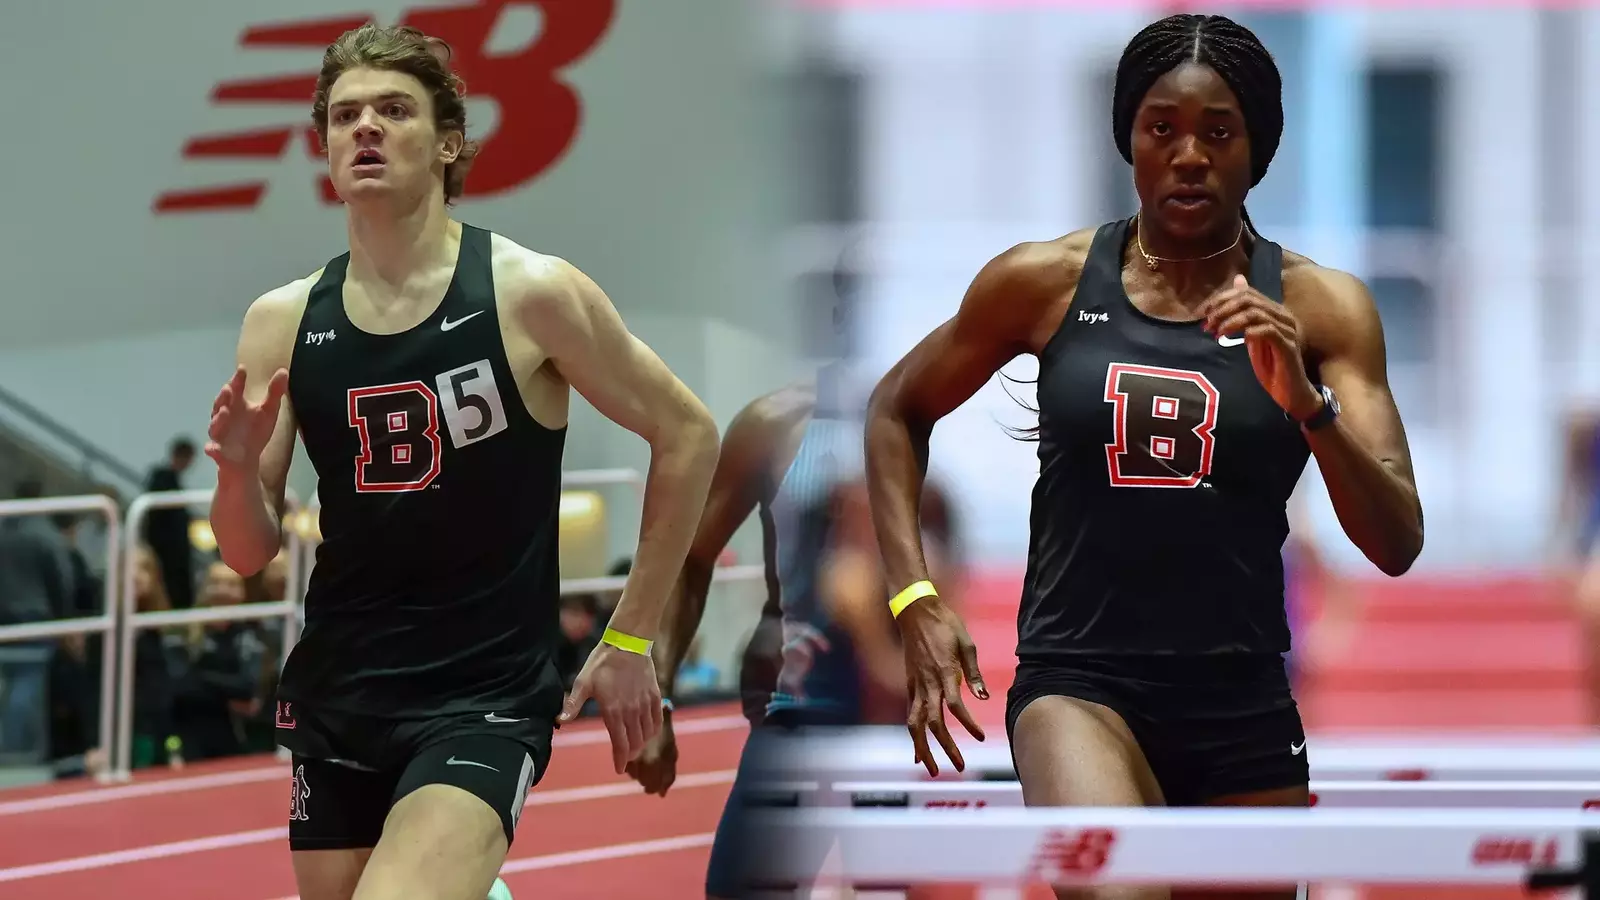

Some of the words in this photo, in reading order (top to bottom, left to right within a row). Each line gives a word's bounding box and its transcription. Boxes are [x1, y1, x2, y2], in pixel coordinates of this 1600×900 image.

[305, 331, 326, 346] Ivy
[1077, 310, 1099, 324] Ivy
[347, 380, 441, 493] B
[449, 367, 493, 440] 5
[1104, 362, 1220, 488] B
